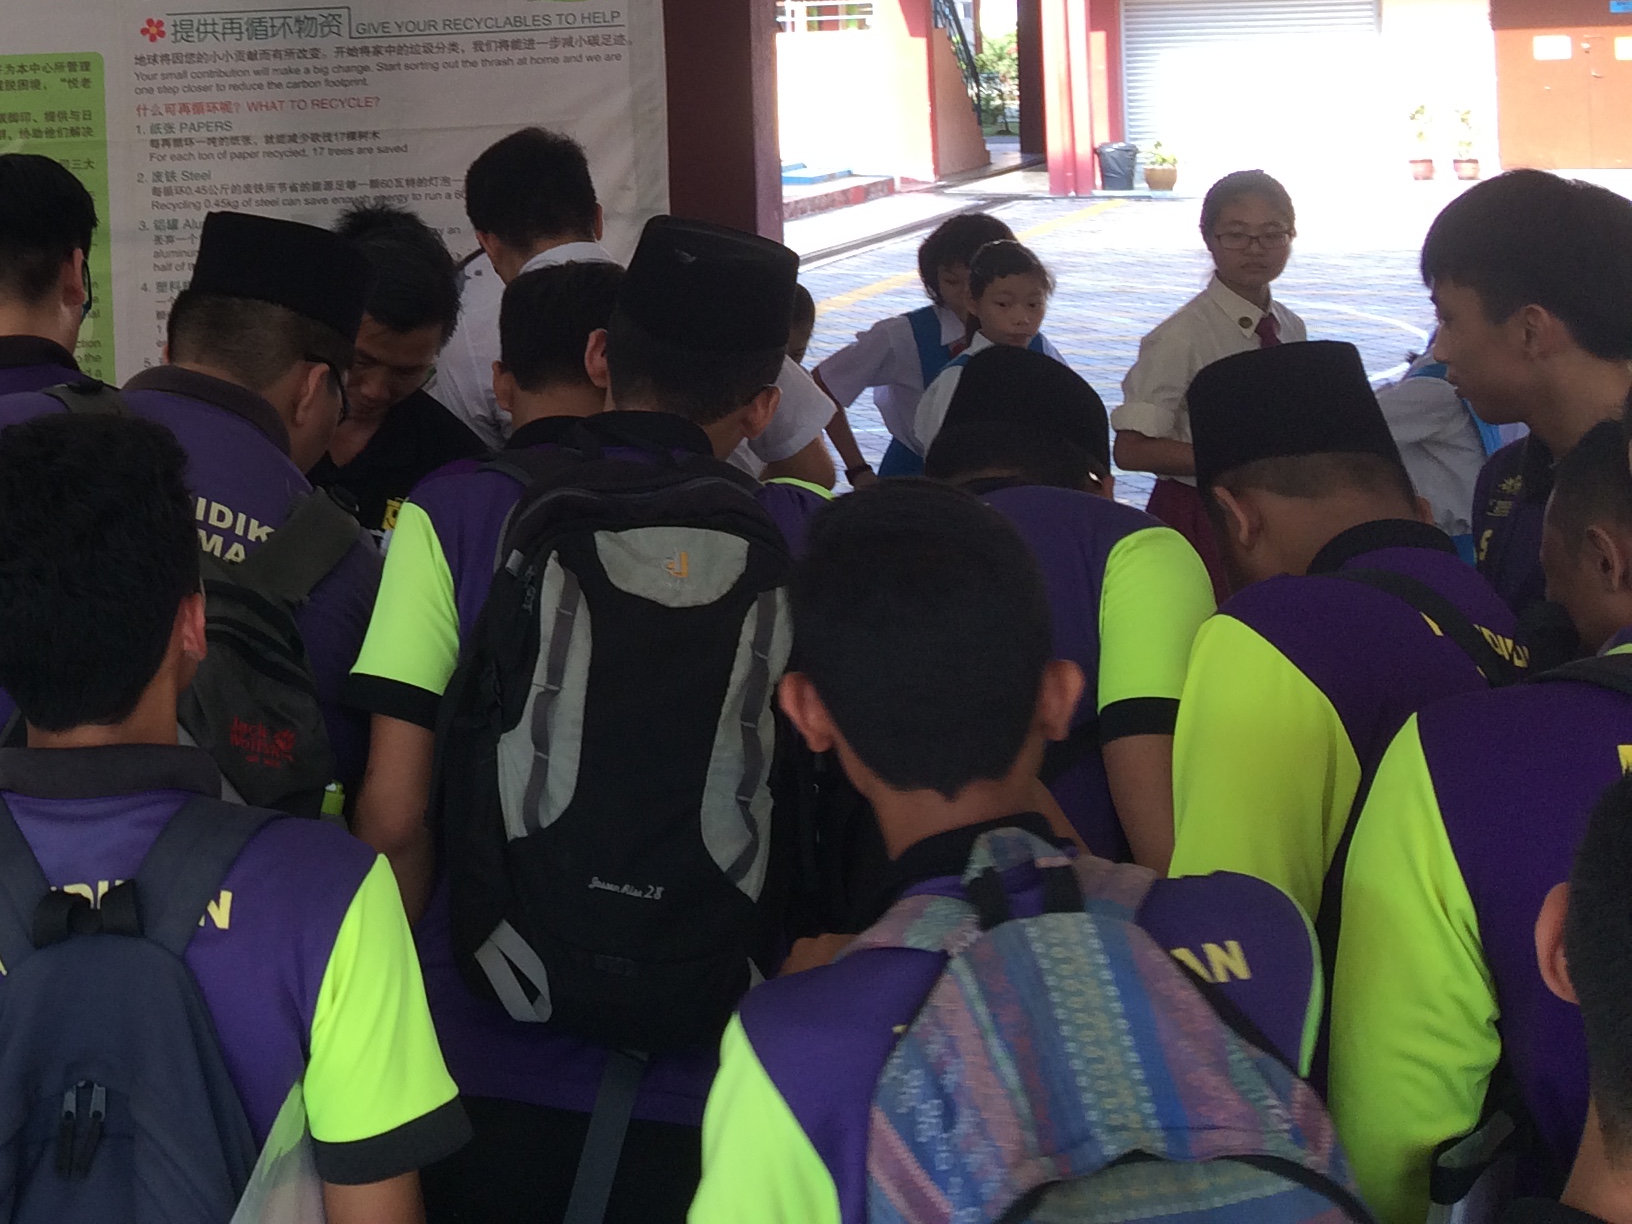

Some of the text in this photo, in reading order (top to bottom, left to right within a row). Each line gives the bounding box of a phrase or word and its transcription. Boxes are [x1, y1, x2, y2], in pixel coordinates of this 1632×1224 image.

[171, 10, 621, 44] 提供再循环物资 GIVE YOUR RECYCLABLES TO HELP
[134, 53, 622, 82] Your small contribution will make a big change. Start sorting out the thrash at home and we are
[134, 86, 155, 95] one
[157, 85, 180, 96] step
[182, 82, 213, 94] closer
[216, 82, 226, 92] to
[228, 80, 264, 91] reduce
[267, 79, 283, 90] the
[286, 78, 322, 89] carbon
[246, 99, 286, 112] WHAT
[289, 98, 308, 111] TO
[310, 96, 381, 110] RECYCLE?
[136, 120, 233, 135] 1. 纸张 PAPERS
[149, 152, 167, 162] For
[169, 151, 195, 162] each
[197, 150, 215, 160] ton
[217, 148, 228, 159] of
[230, 149, 260, 161] paper
[312, 146, 325, 157] 17
[327, 146, 354, 156] trees
[356, 146, 373, 155] are
[376, 144, 409, 155] saved
[137, 173, 148, 184] 2.
[181, 170, 211, 182] Steel
[151, 198, 202, 211] Recycling
[204, 198, 239, 209] 0.45kg
[241, 197, 253, 207] of
[254, 196, 279, 207] steel
[282, 197, 302, 206] can
[304, 197, 328, 206] save
[412, 192, 422, 201] to
[424, 192, 442, 201] run
[153, 262, 173, 272] half
[175, 261, 186, 271] of
